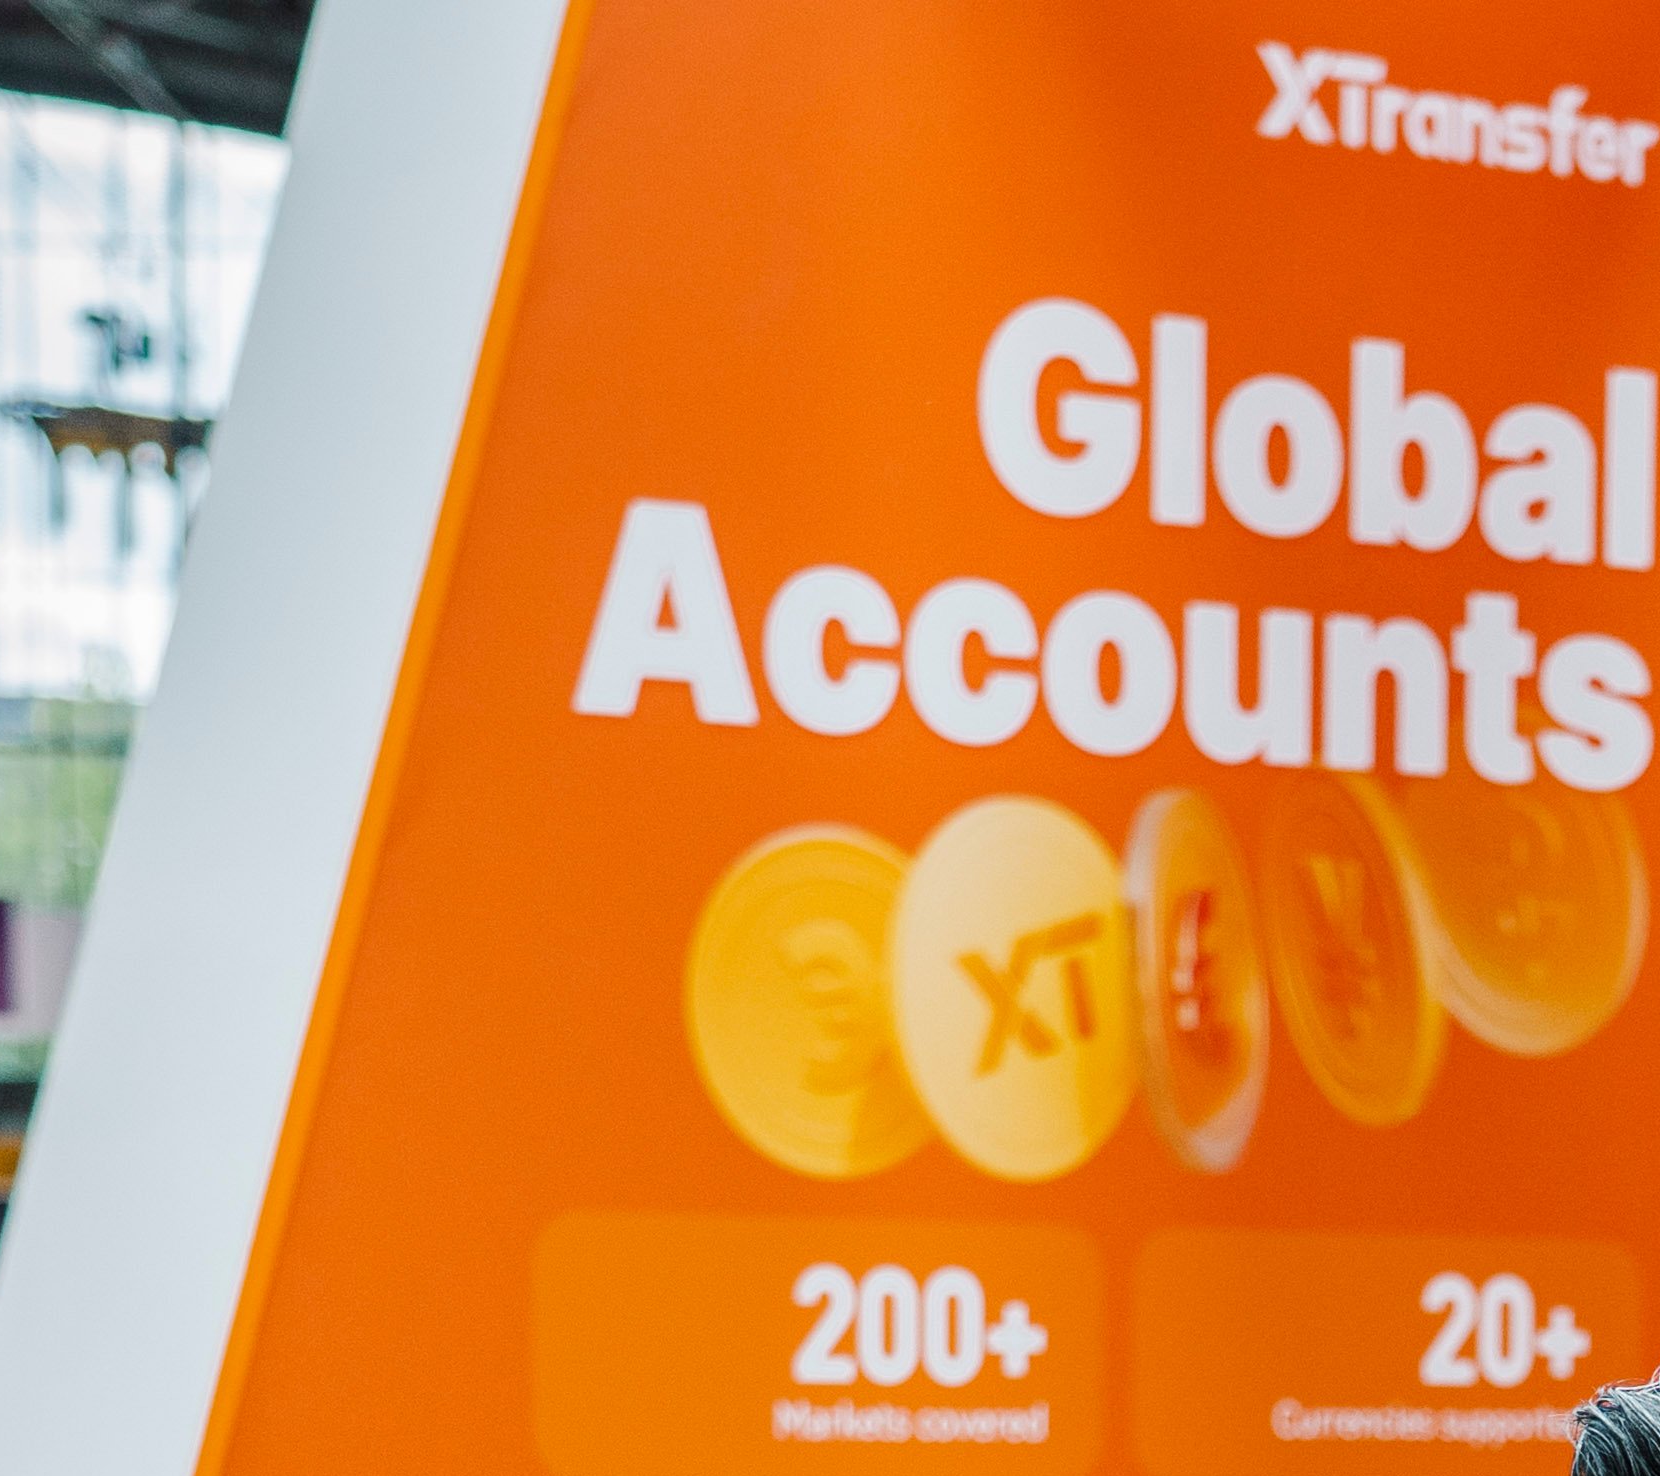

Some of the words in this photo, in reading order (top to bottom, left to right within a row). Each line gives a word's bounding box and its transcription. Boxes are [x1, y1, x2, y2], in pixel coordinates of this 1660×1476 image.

[976, 296, 1658, 572] Global
[571, 495, 1656, 791] Accounts
[791, 1262, 1049, 1387] 200+
[1420, 1271, 1592, 1389] 20+
[771, 1399, 912, 1442] Markets
[915, 1401, 1049, 1444] covered
